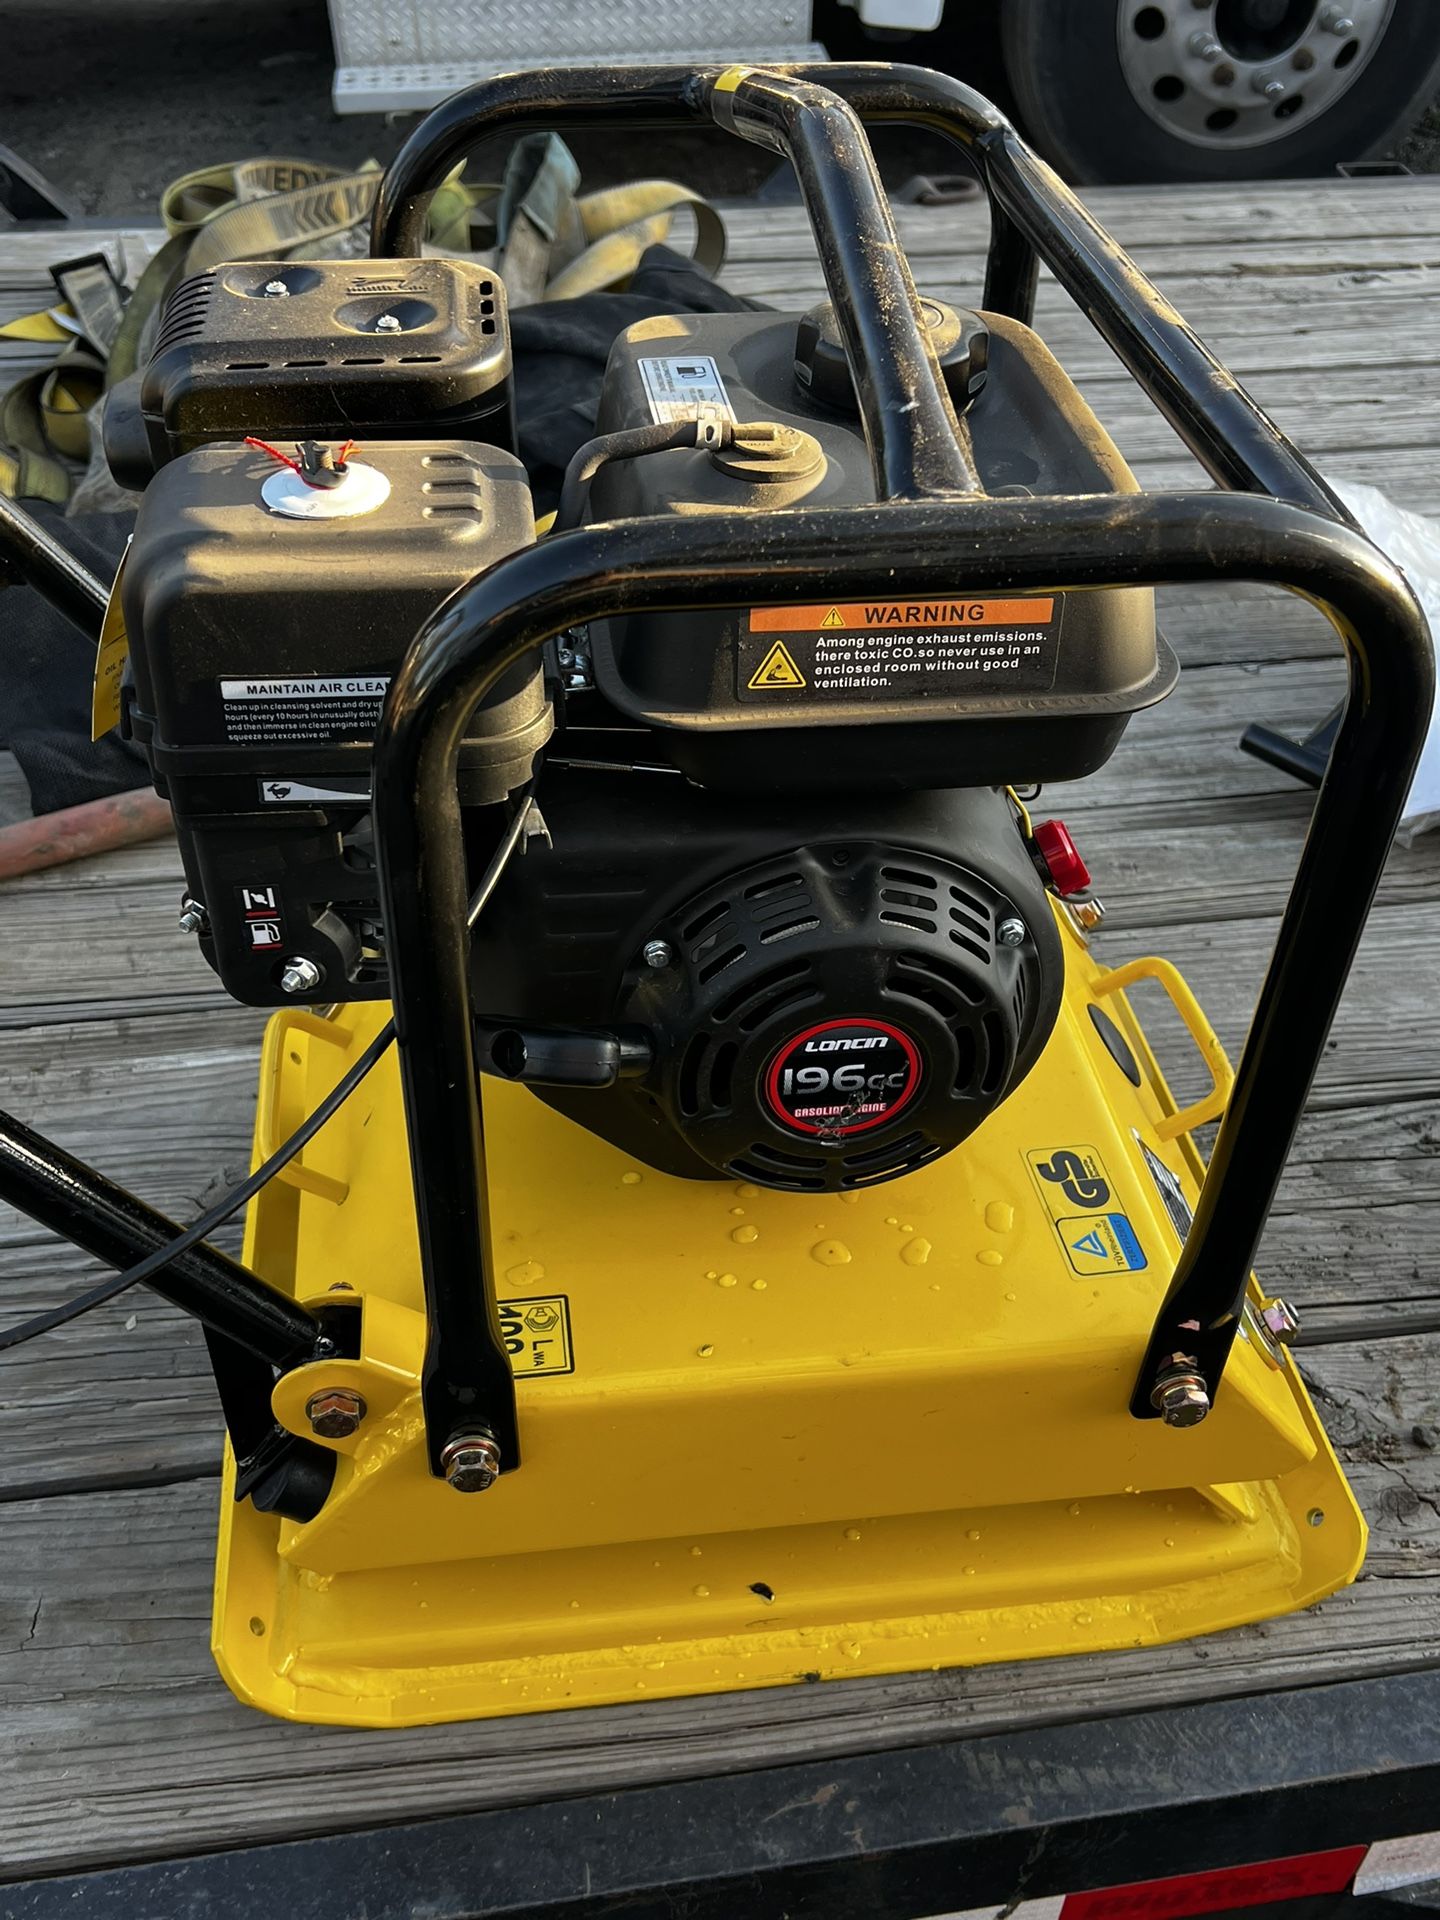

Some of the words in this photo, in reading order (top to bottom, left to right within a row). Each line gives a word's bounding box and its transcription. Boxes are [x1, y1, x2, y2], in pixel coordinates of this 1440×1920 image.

[864, 604, 985, 624] WARNING
[815, 637, 865, 649] Among
[867, 634, 914, 647] engine
[916, 632, 972, 645] exhaust
[973, 630, 1047, 643] emissions.
[815, 650, 851, 662] there
[854, 648, 889, 660] toxic
[938, 647, 977, 657] never
[980, 646, 1005, 656] use
[1007, 644, 1021, 655] in
[1023, 645, 1041, 655] an
[814, 662, 881, 676] enclosed
[884, 662, 922, 673] room
[925, 659, 980, 671] without
[982, 657, 1019, 671] good
[246, 683, 316, 694] MAINTAIN
[318, 682, 343, 693] AIR
[814, 676, 892, 689] ventilation.
[223, 703, 248, 711] Clean
[248, 704, 260, 712] up
[269, 701, 310, 710] cleansing
[310, 701, 341, 709] solvent
[358, 700, 372, 709] dry
[224, 713, 249, 721] hours
[249, 713, 275, 722] (every
[275, 712, 286, 720] 10
[286, 711, 310, 720] hours
[310, 711, 319, 719] in
[319, 711, 358, 719] unusually
[226, 722, 243, 731] and
[243, 722, 262, 730] then
[262, 720, 298, 730] immerse
[298, 720, 307, 729] in
[307, 720, 330, 729] clean
[330, 719, 358, 730] engine
[359, 719, 370, 728] oil
[228, 731, 263, 742] squeeze
[263, 731, 277, 740] out
[277, 731, 318, 740] excessive
[804, 1036, 889, 1053] LONCIN
[851, 1102, 887, 1114] GINE
[1036, 1150, 1110, 1208] GS
